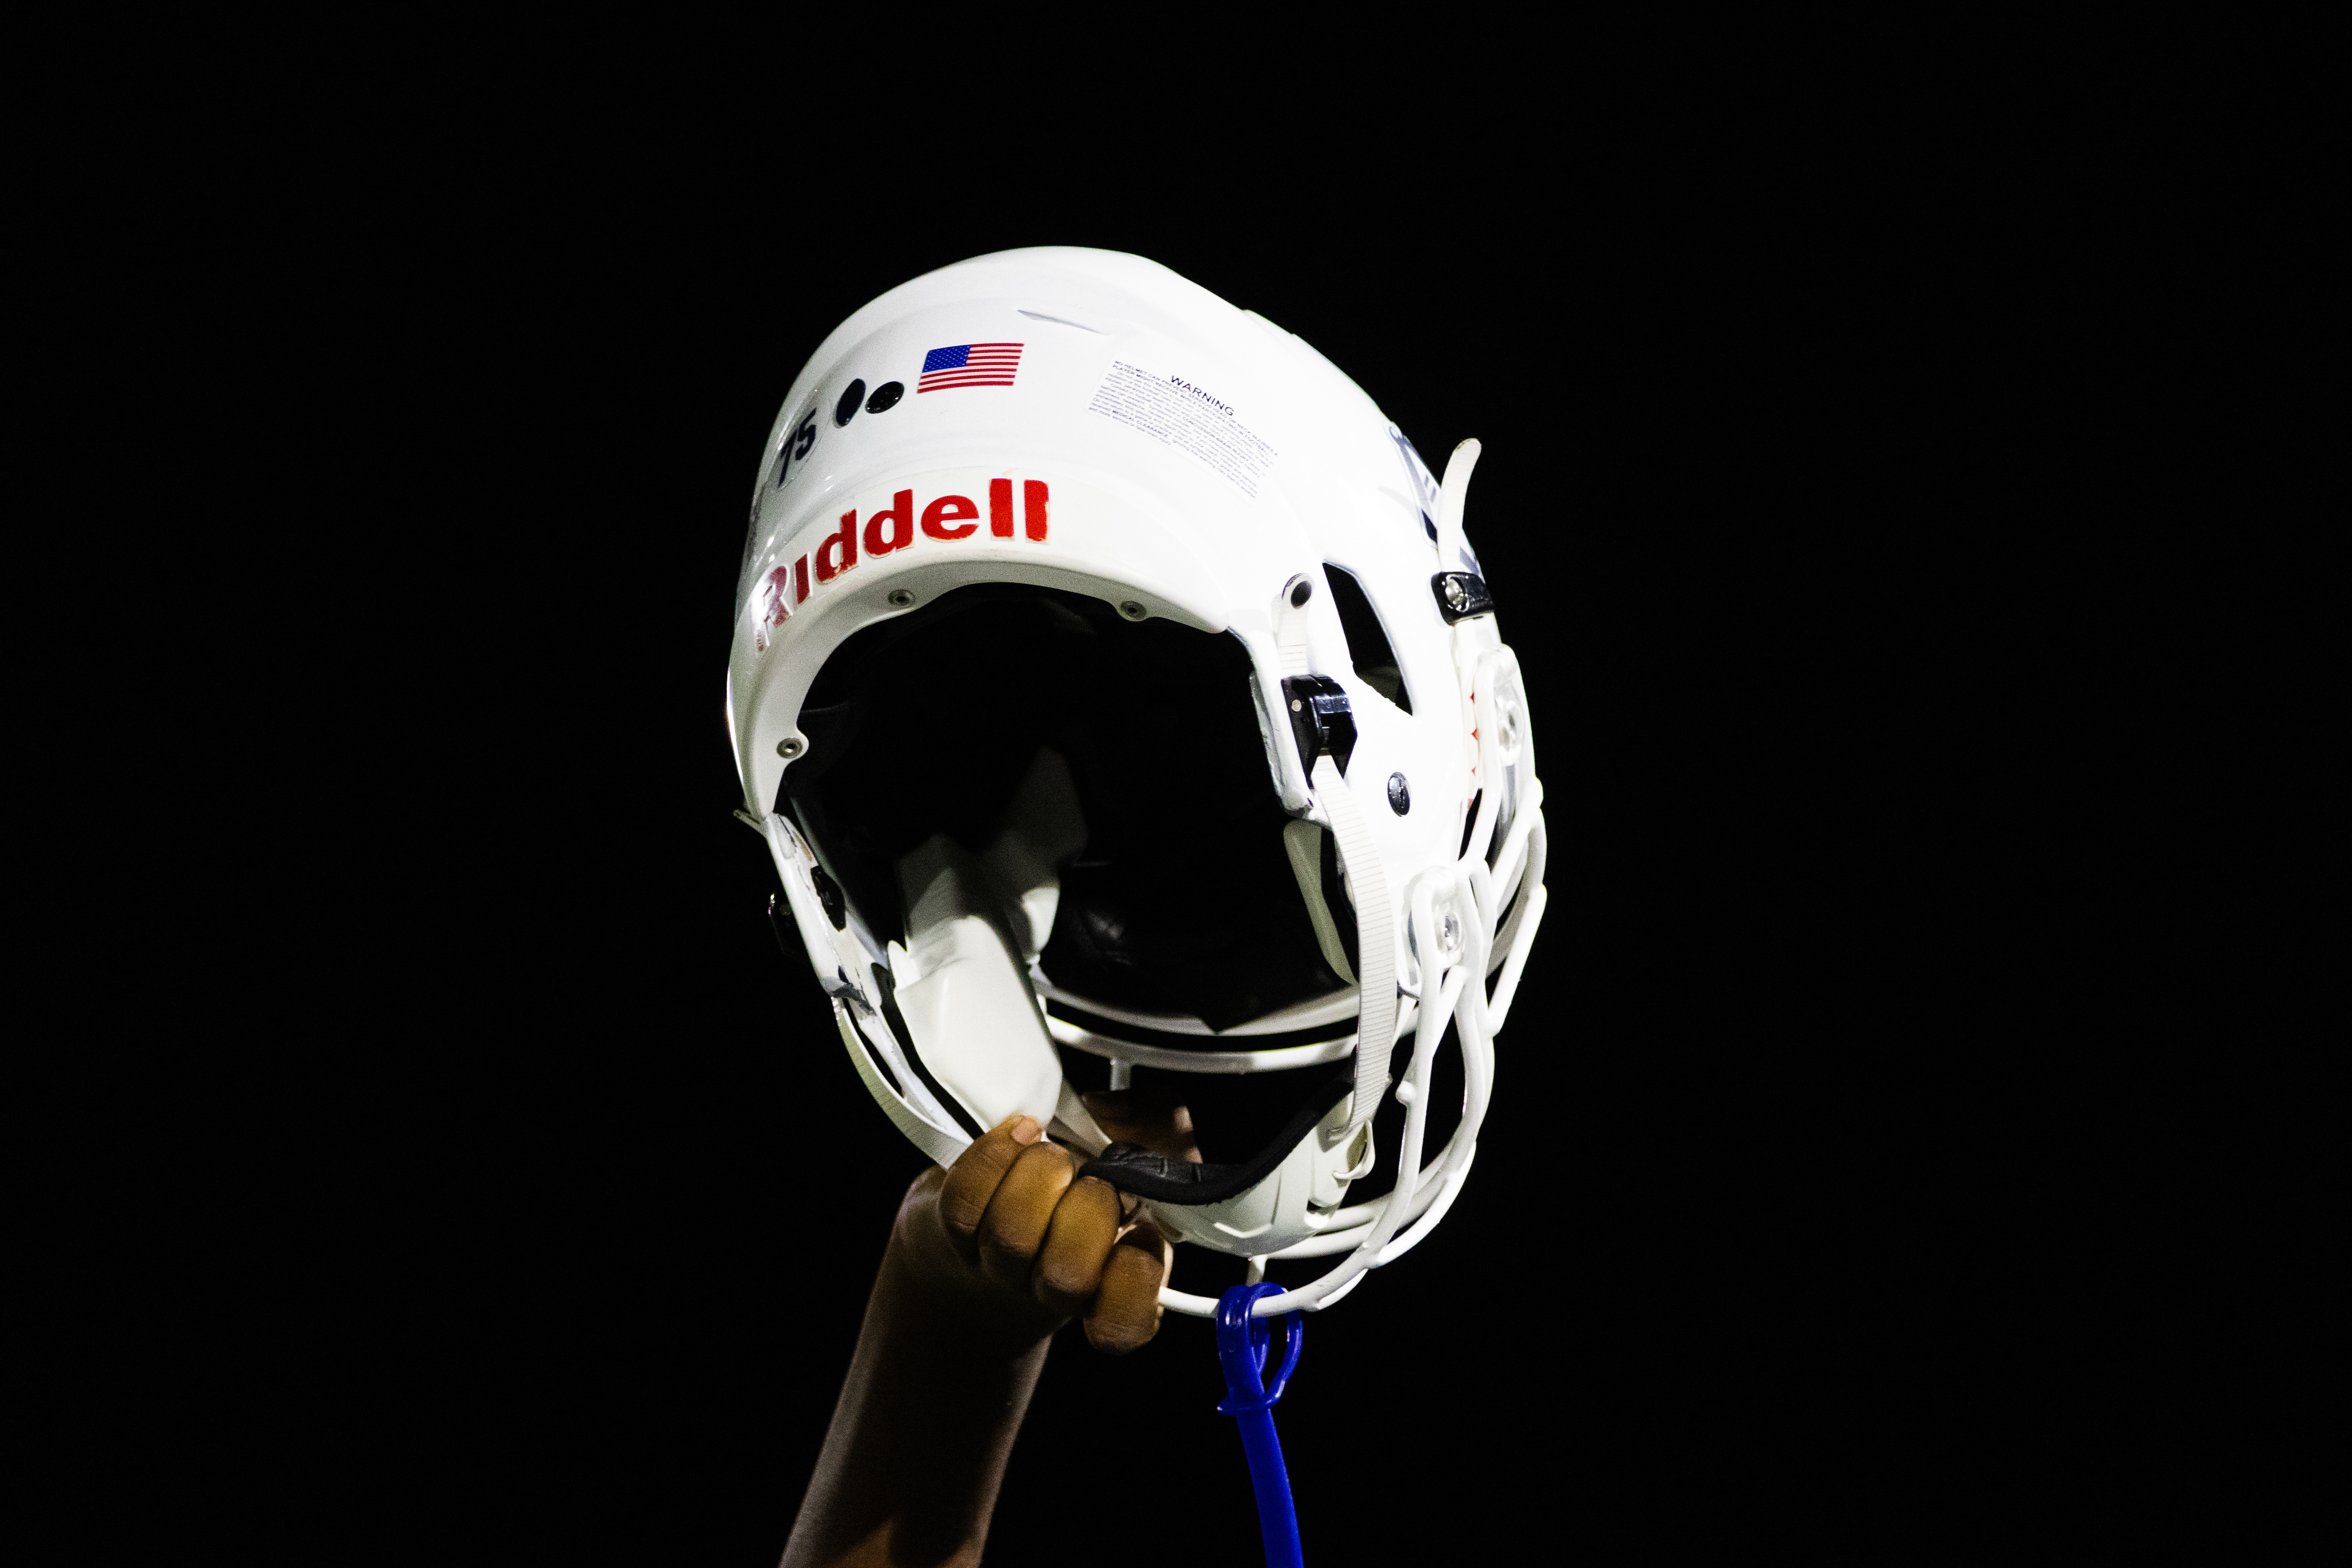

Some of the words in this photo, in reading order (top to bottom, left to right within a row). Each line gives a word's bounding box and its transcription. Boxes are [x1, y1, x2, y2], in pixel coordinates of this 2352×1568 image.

[1172, 375, 1234, 416] WARNING
[777, 407, 817, 488] 75
[751, 478, 1049, 653] Riddell
